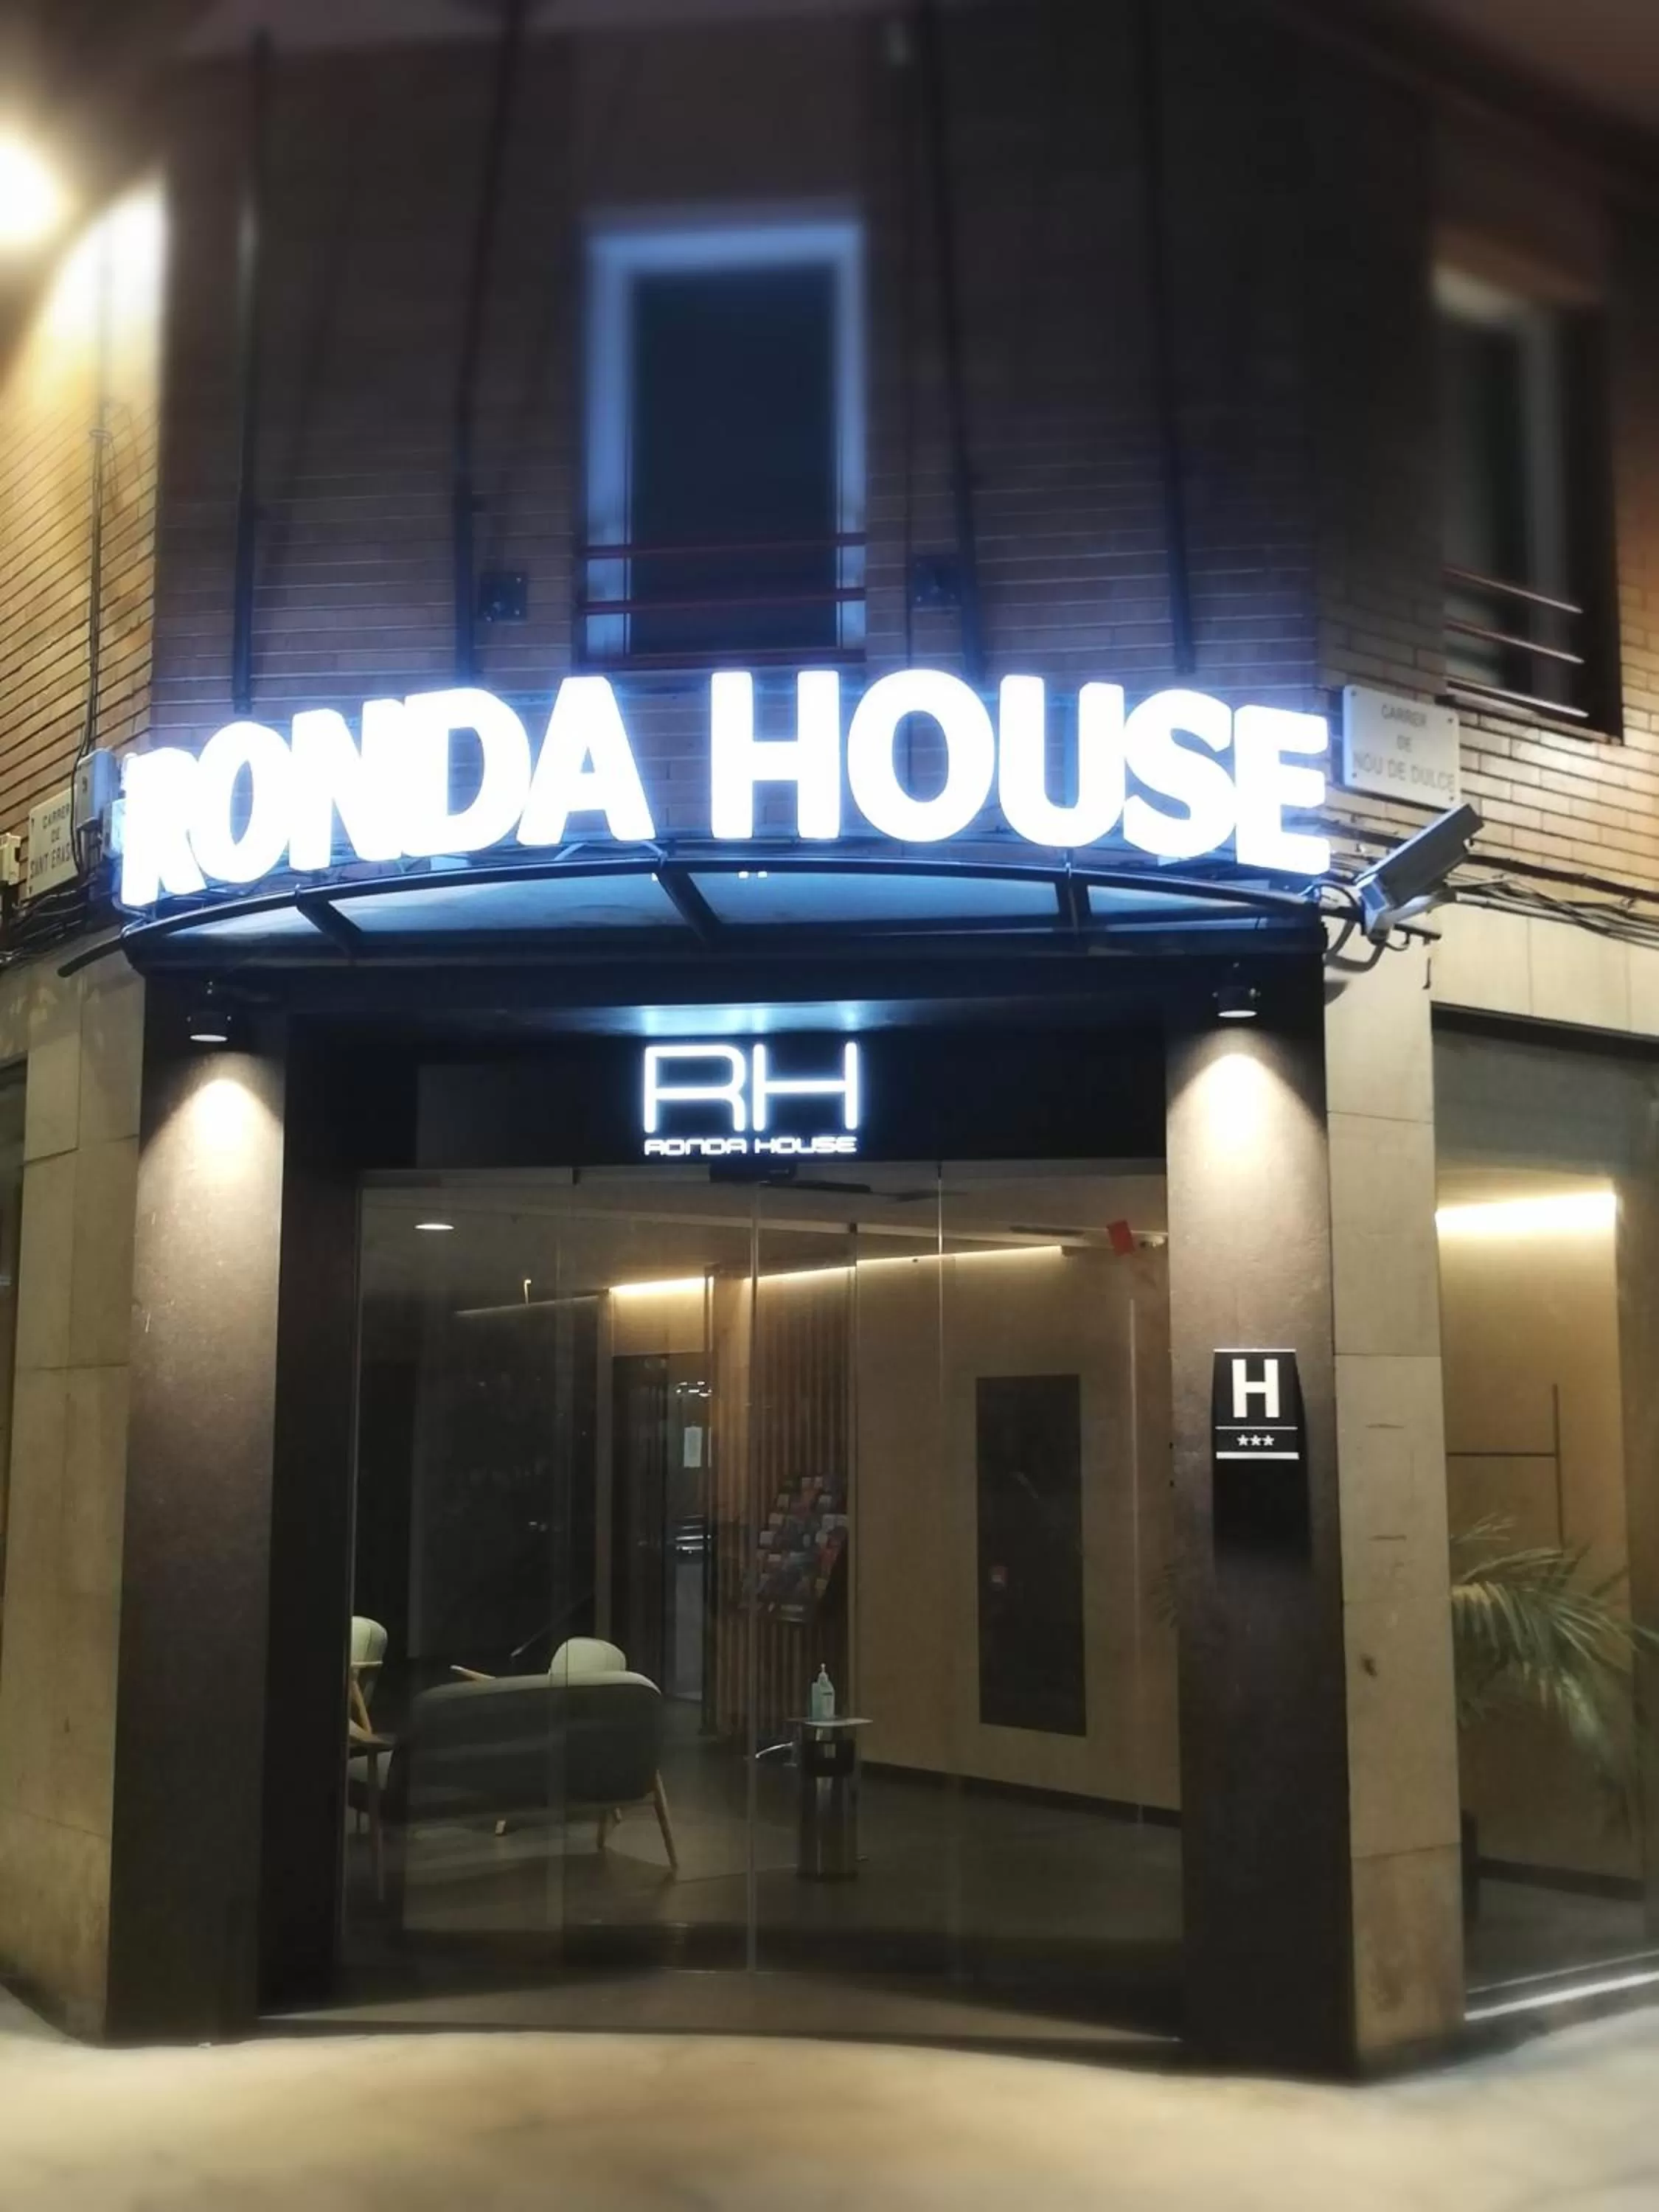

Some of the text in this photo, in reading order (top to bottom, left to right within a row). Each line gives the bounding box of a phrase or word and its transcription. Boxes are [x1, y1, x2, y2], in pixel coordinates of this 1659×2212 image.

[1381, 703, 1427, 727] CARRER
[1397, 734, 1413, 753] DE
[121, 669, 1330, 906] RONDA HOUSE
[1352, 751, 1455, 793] NOU DE DULCE
[42, 803, 69, 830] CARRER
[644, 1041, 858, 1134] RH
[644, 1135, 858, 1156] RONDA HOUSE
[1232, 1358, 1280, 1419] H
